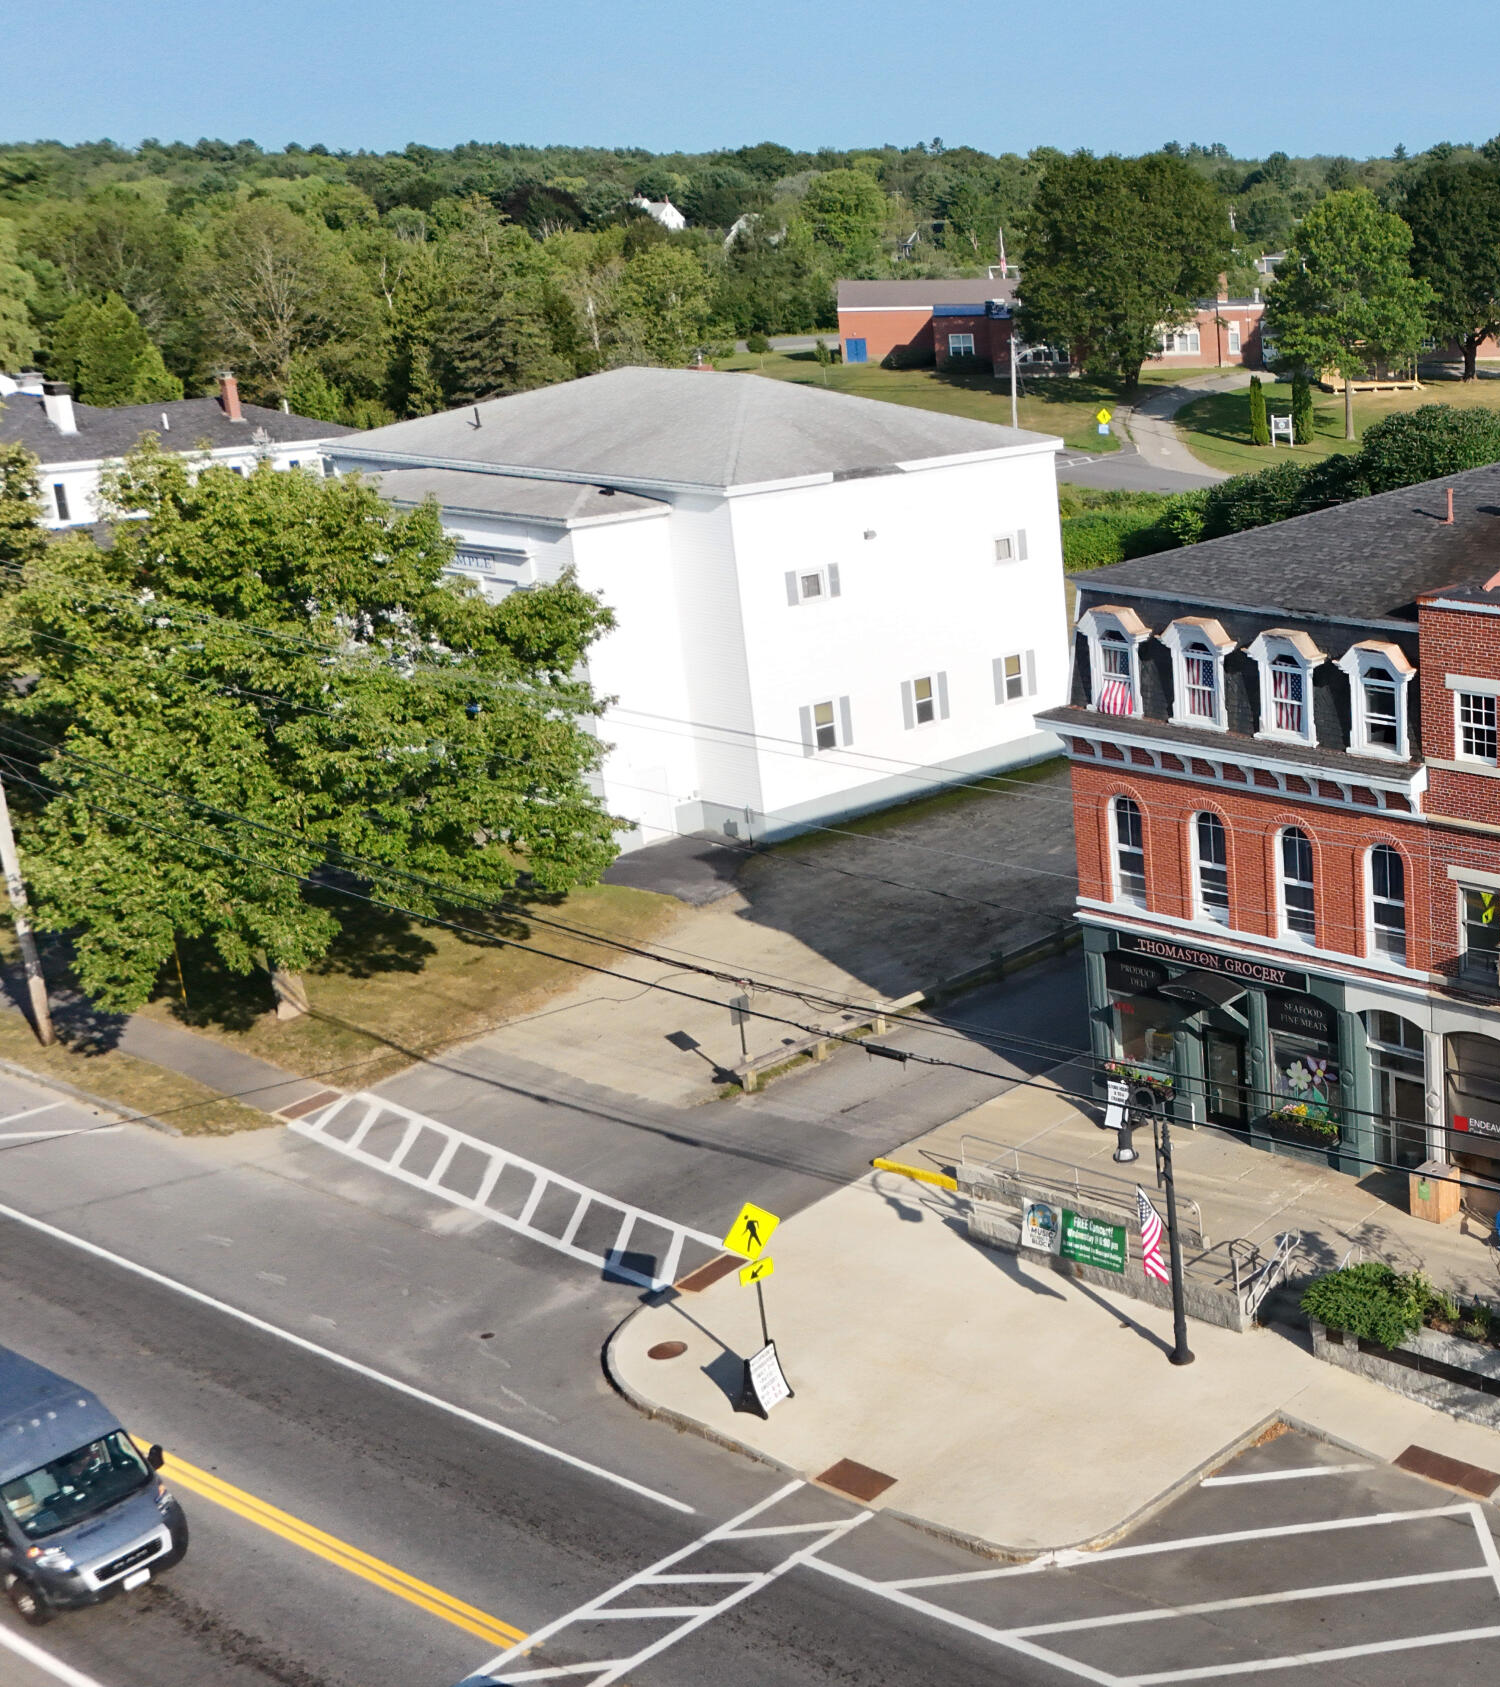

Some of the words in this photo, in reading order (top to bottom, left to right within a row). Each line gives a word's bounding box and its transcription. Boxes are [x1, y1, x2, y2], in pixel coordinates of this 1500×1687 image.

[1138, 938, 1219, 968] THOMASTON
[1225, 959, 1286, 983] GROCERY
[1284, 1003, 1322, 1018] SEAFOOD
[1281, 1014, 1299, 1025] FINE
[1301, 1018, 1328, 1032] MEATS
[1073, 1217, 1089, 1230] FREE
[1031, 1227, 1054, 1239] MUSIC
